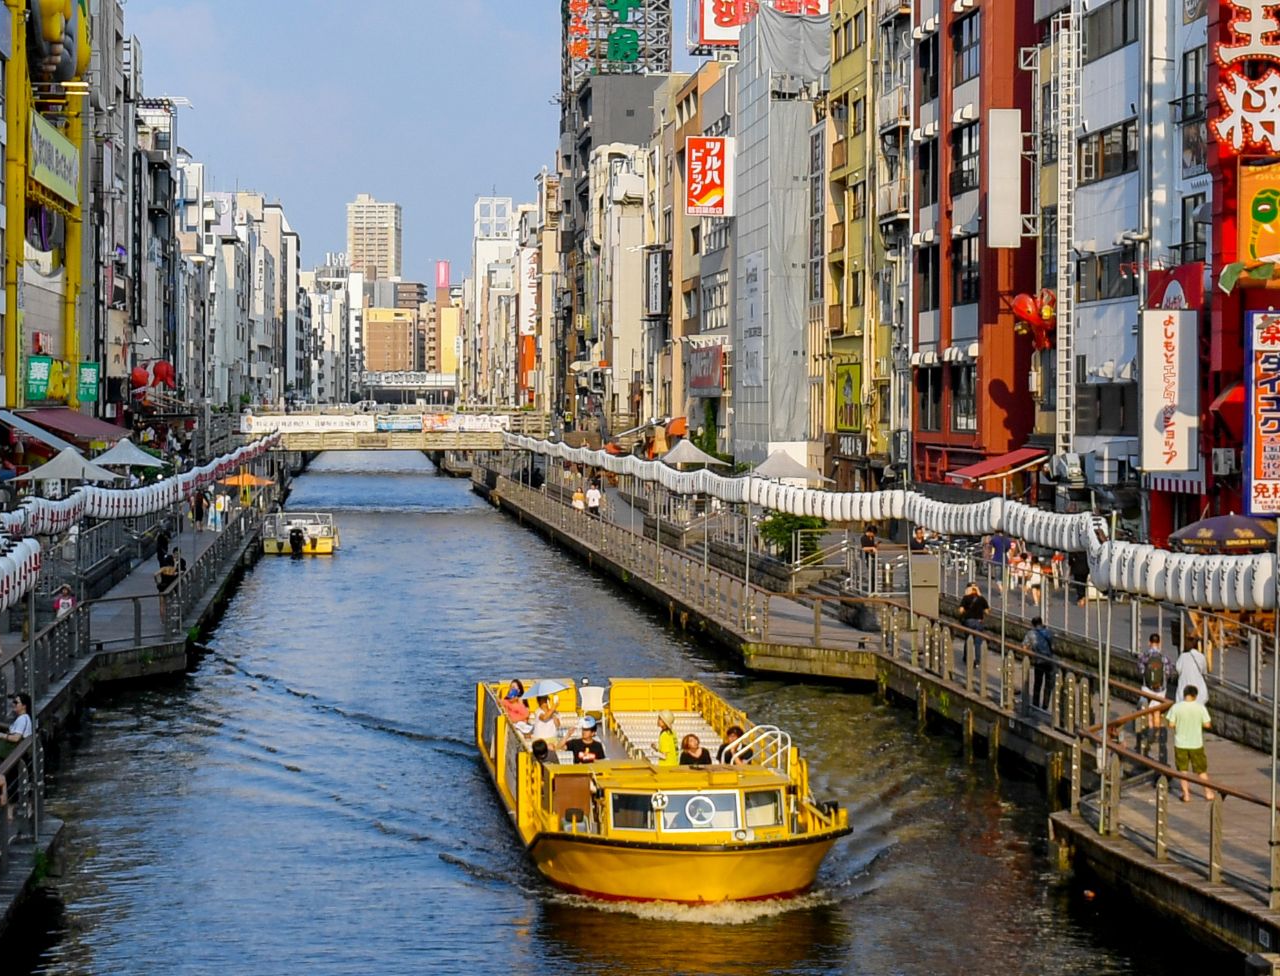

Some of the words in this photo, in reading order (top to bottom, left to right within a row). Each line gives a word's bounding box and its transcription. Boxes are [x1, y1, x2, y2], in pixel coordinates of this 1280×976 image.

[690, 149, 704, 196] ドラッグ
[705, 141, 721, 184] ツルハ
